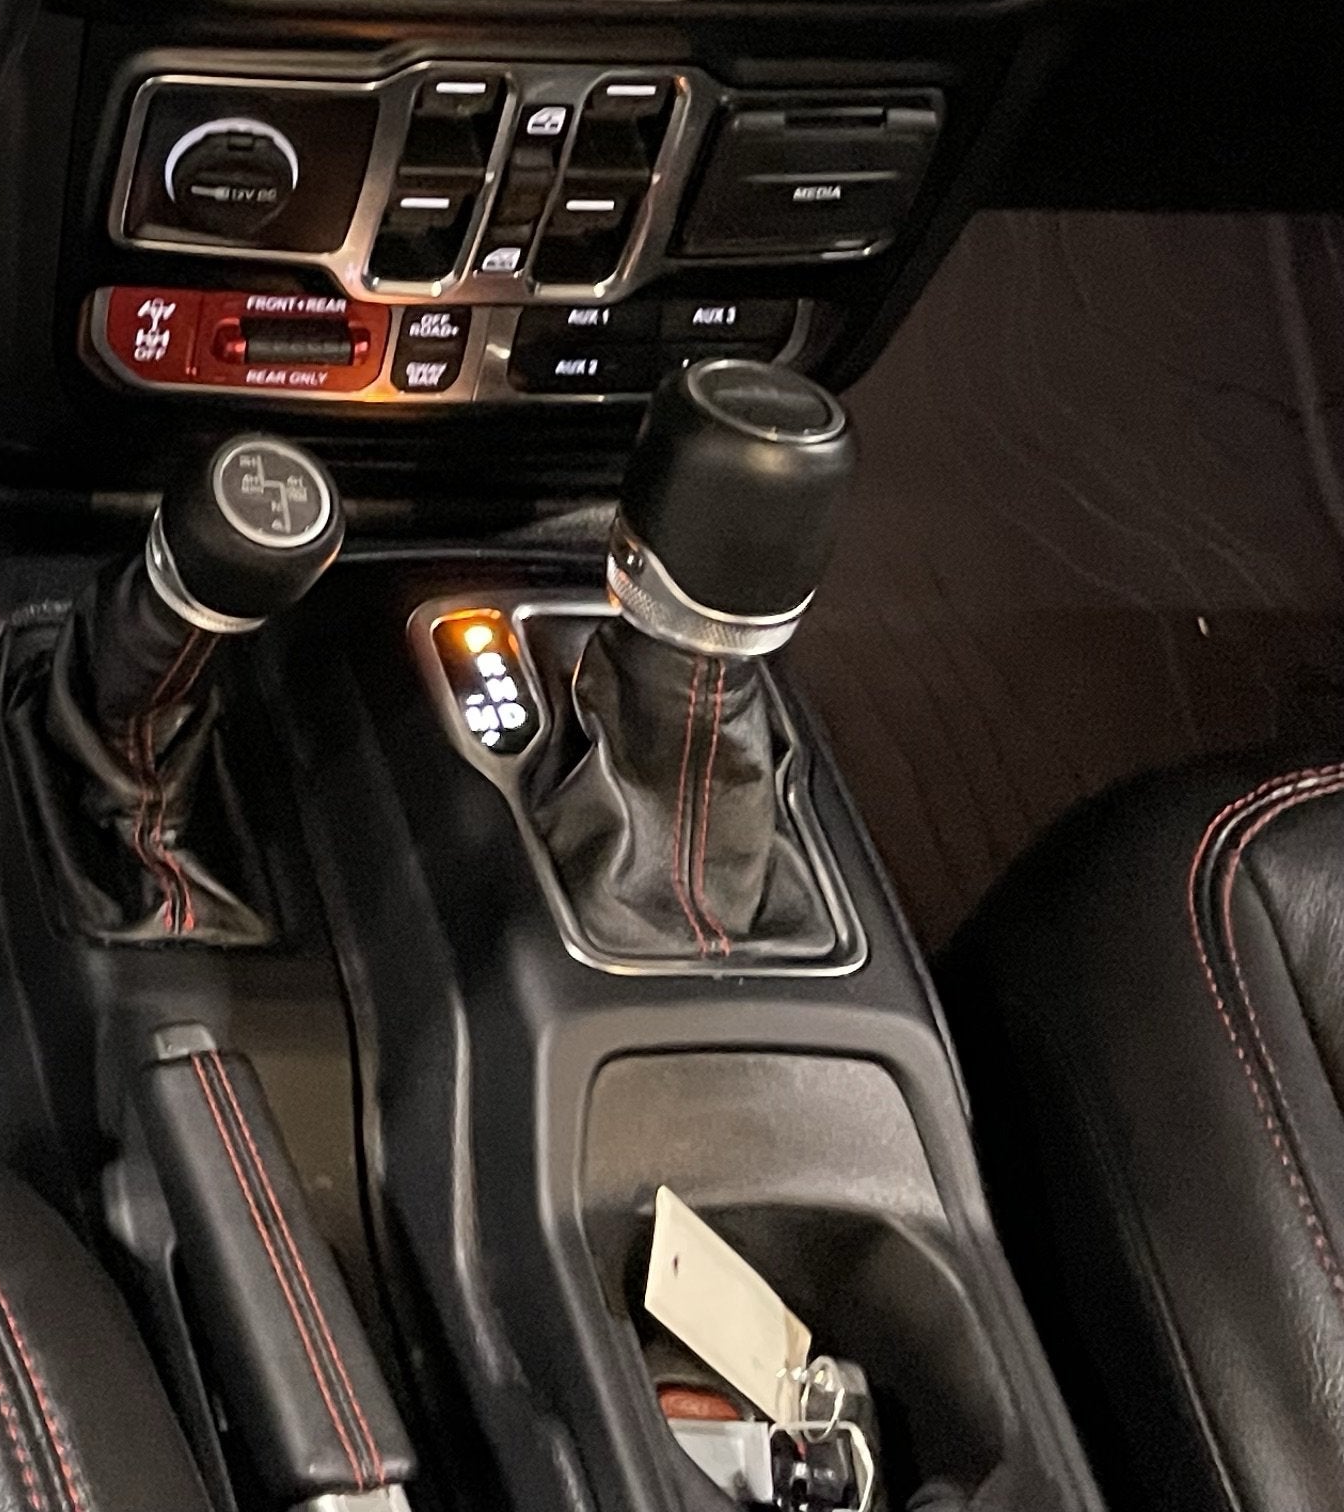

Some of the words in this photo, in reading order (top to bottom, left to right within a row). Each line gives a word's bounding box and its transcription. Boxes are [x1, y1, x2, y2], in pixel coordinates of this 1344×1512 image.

[792, 185, 842, 202] MEDIA
[567, 308, 600, 326] AUX
[692, 306, 725, 325] AUX
[555, 359, 587, 376] AUX
[246, 369, 287, 385] REAR
[289, 371, 328, 386] ONLY
